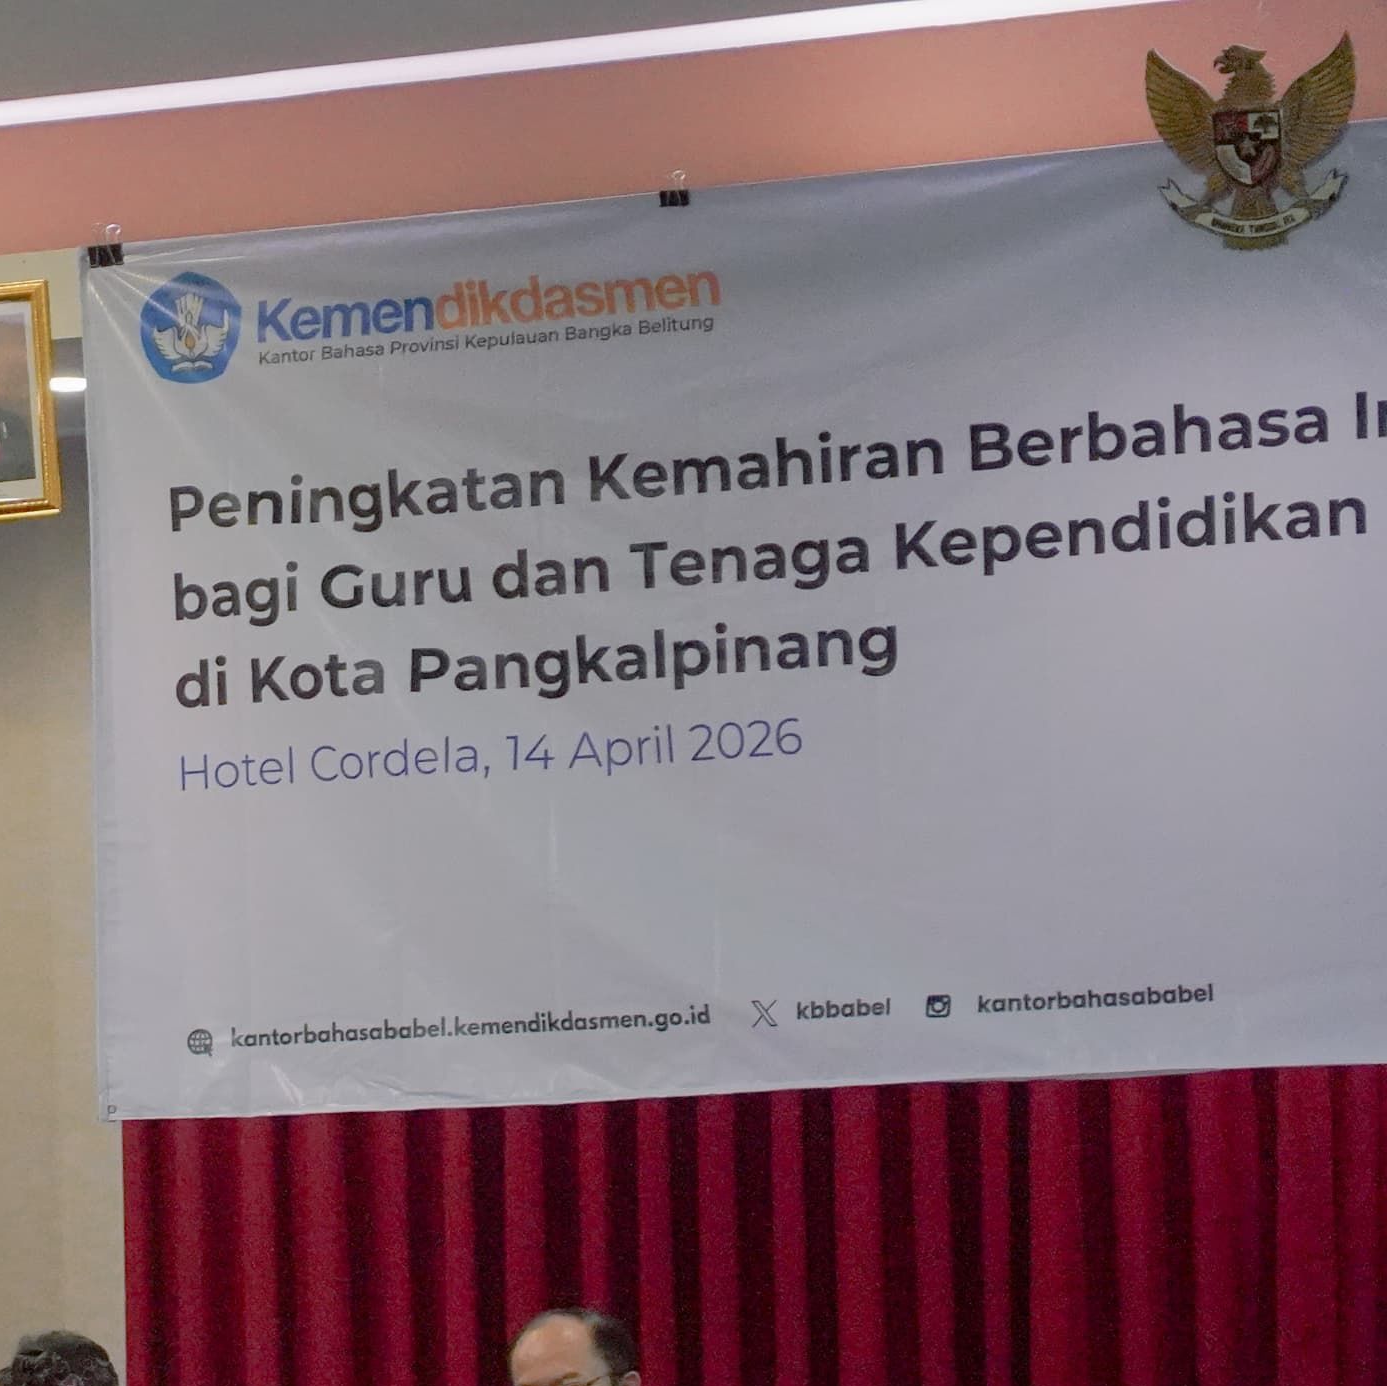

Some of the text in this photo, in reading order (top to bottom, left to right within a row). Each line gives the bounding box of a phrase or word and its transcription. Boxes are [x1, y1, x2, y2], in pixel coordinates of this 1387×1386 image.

[256, 268, 723, 344] Kemendikdasmen
[258, 316, 714, 366] Kantor Bahasa Provinsi Kepulauan Bangka Belitung
[169, 391, 1387, 533] Peningkatan Kemahiran Berbahasa I
[173, 490, 1367, 628] bagi Guru dan Tenaga Kependidikan
[175, 621, 898, 709] di Kota Pangkalpinang
[180, 717, 803, 792] Hotel Cordela, 14 April 2026
[230, 1003, 712, 1048] kantorbahasababel.kemendikdasmen.go.id
[796, 997, 892, 1021] kbbabel
[977, 982, 1214, 1014] kantorbahasababel
